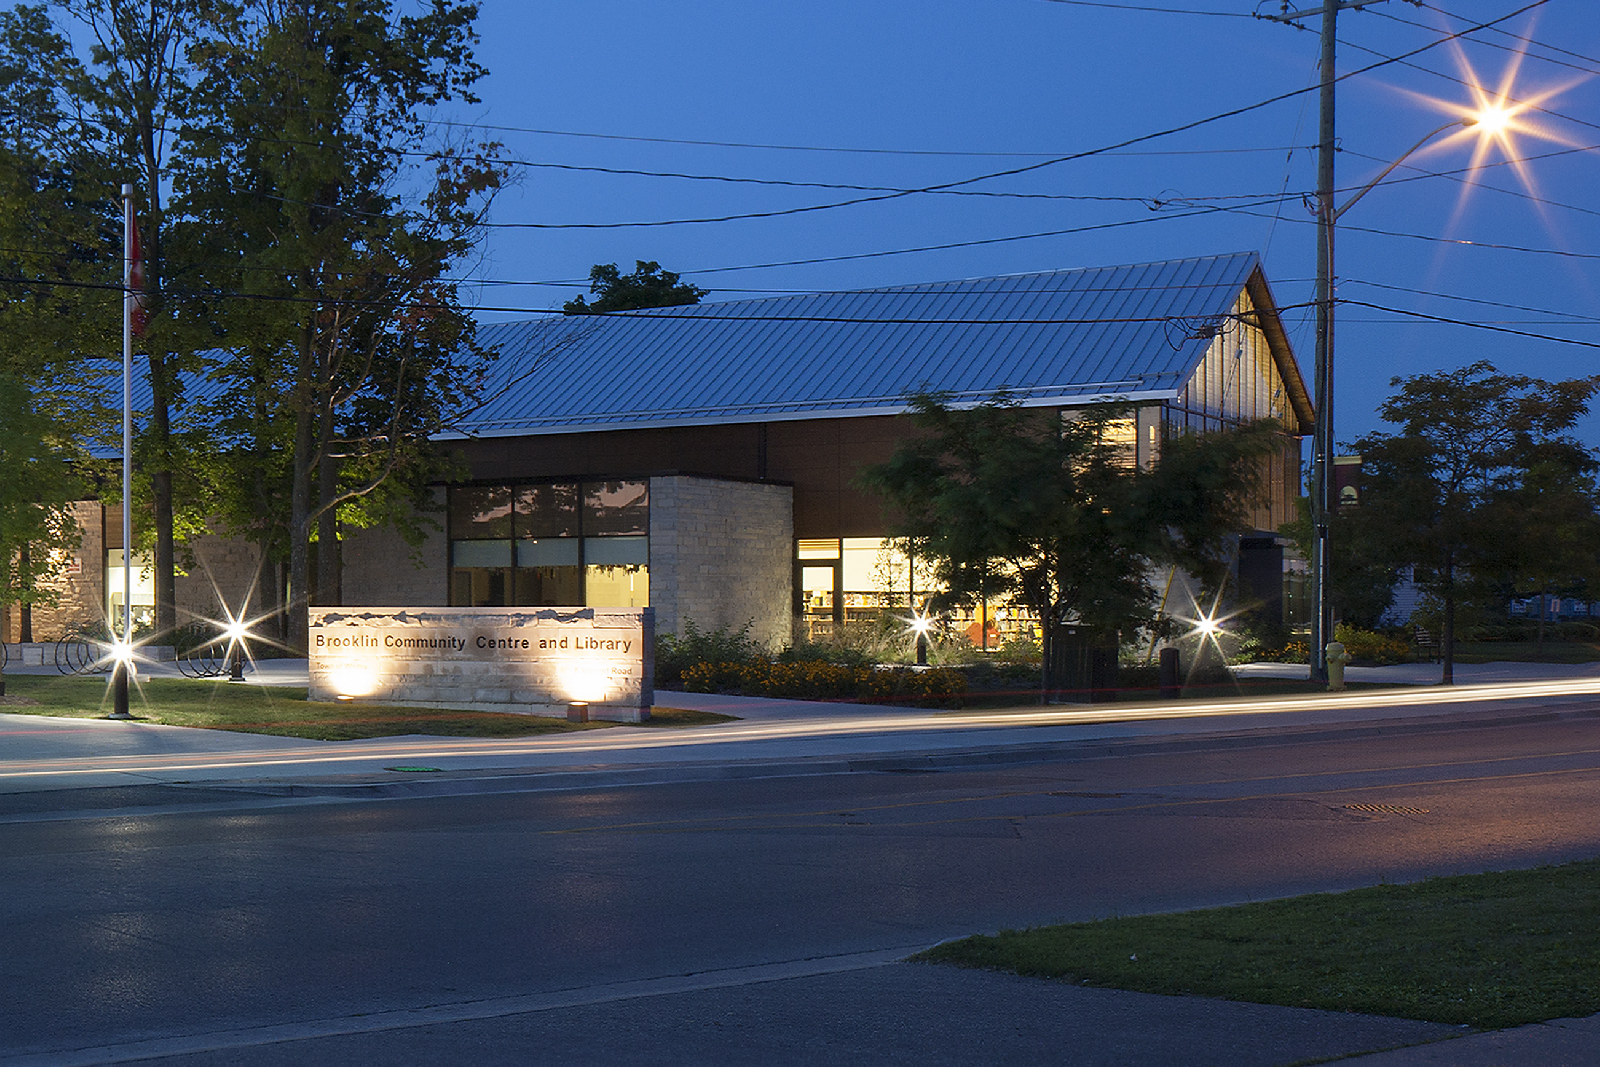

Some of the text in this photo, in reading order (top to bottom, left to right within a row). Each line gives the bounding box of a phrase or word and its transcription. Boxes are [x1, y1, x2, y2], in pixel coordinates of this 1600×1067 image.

[315, 634, 632, 654] Brooklin Community Centre and Library
[611, 666, 633, 676] Road
